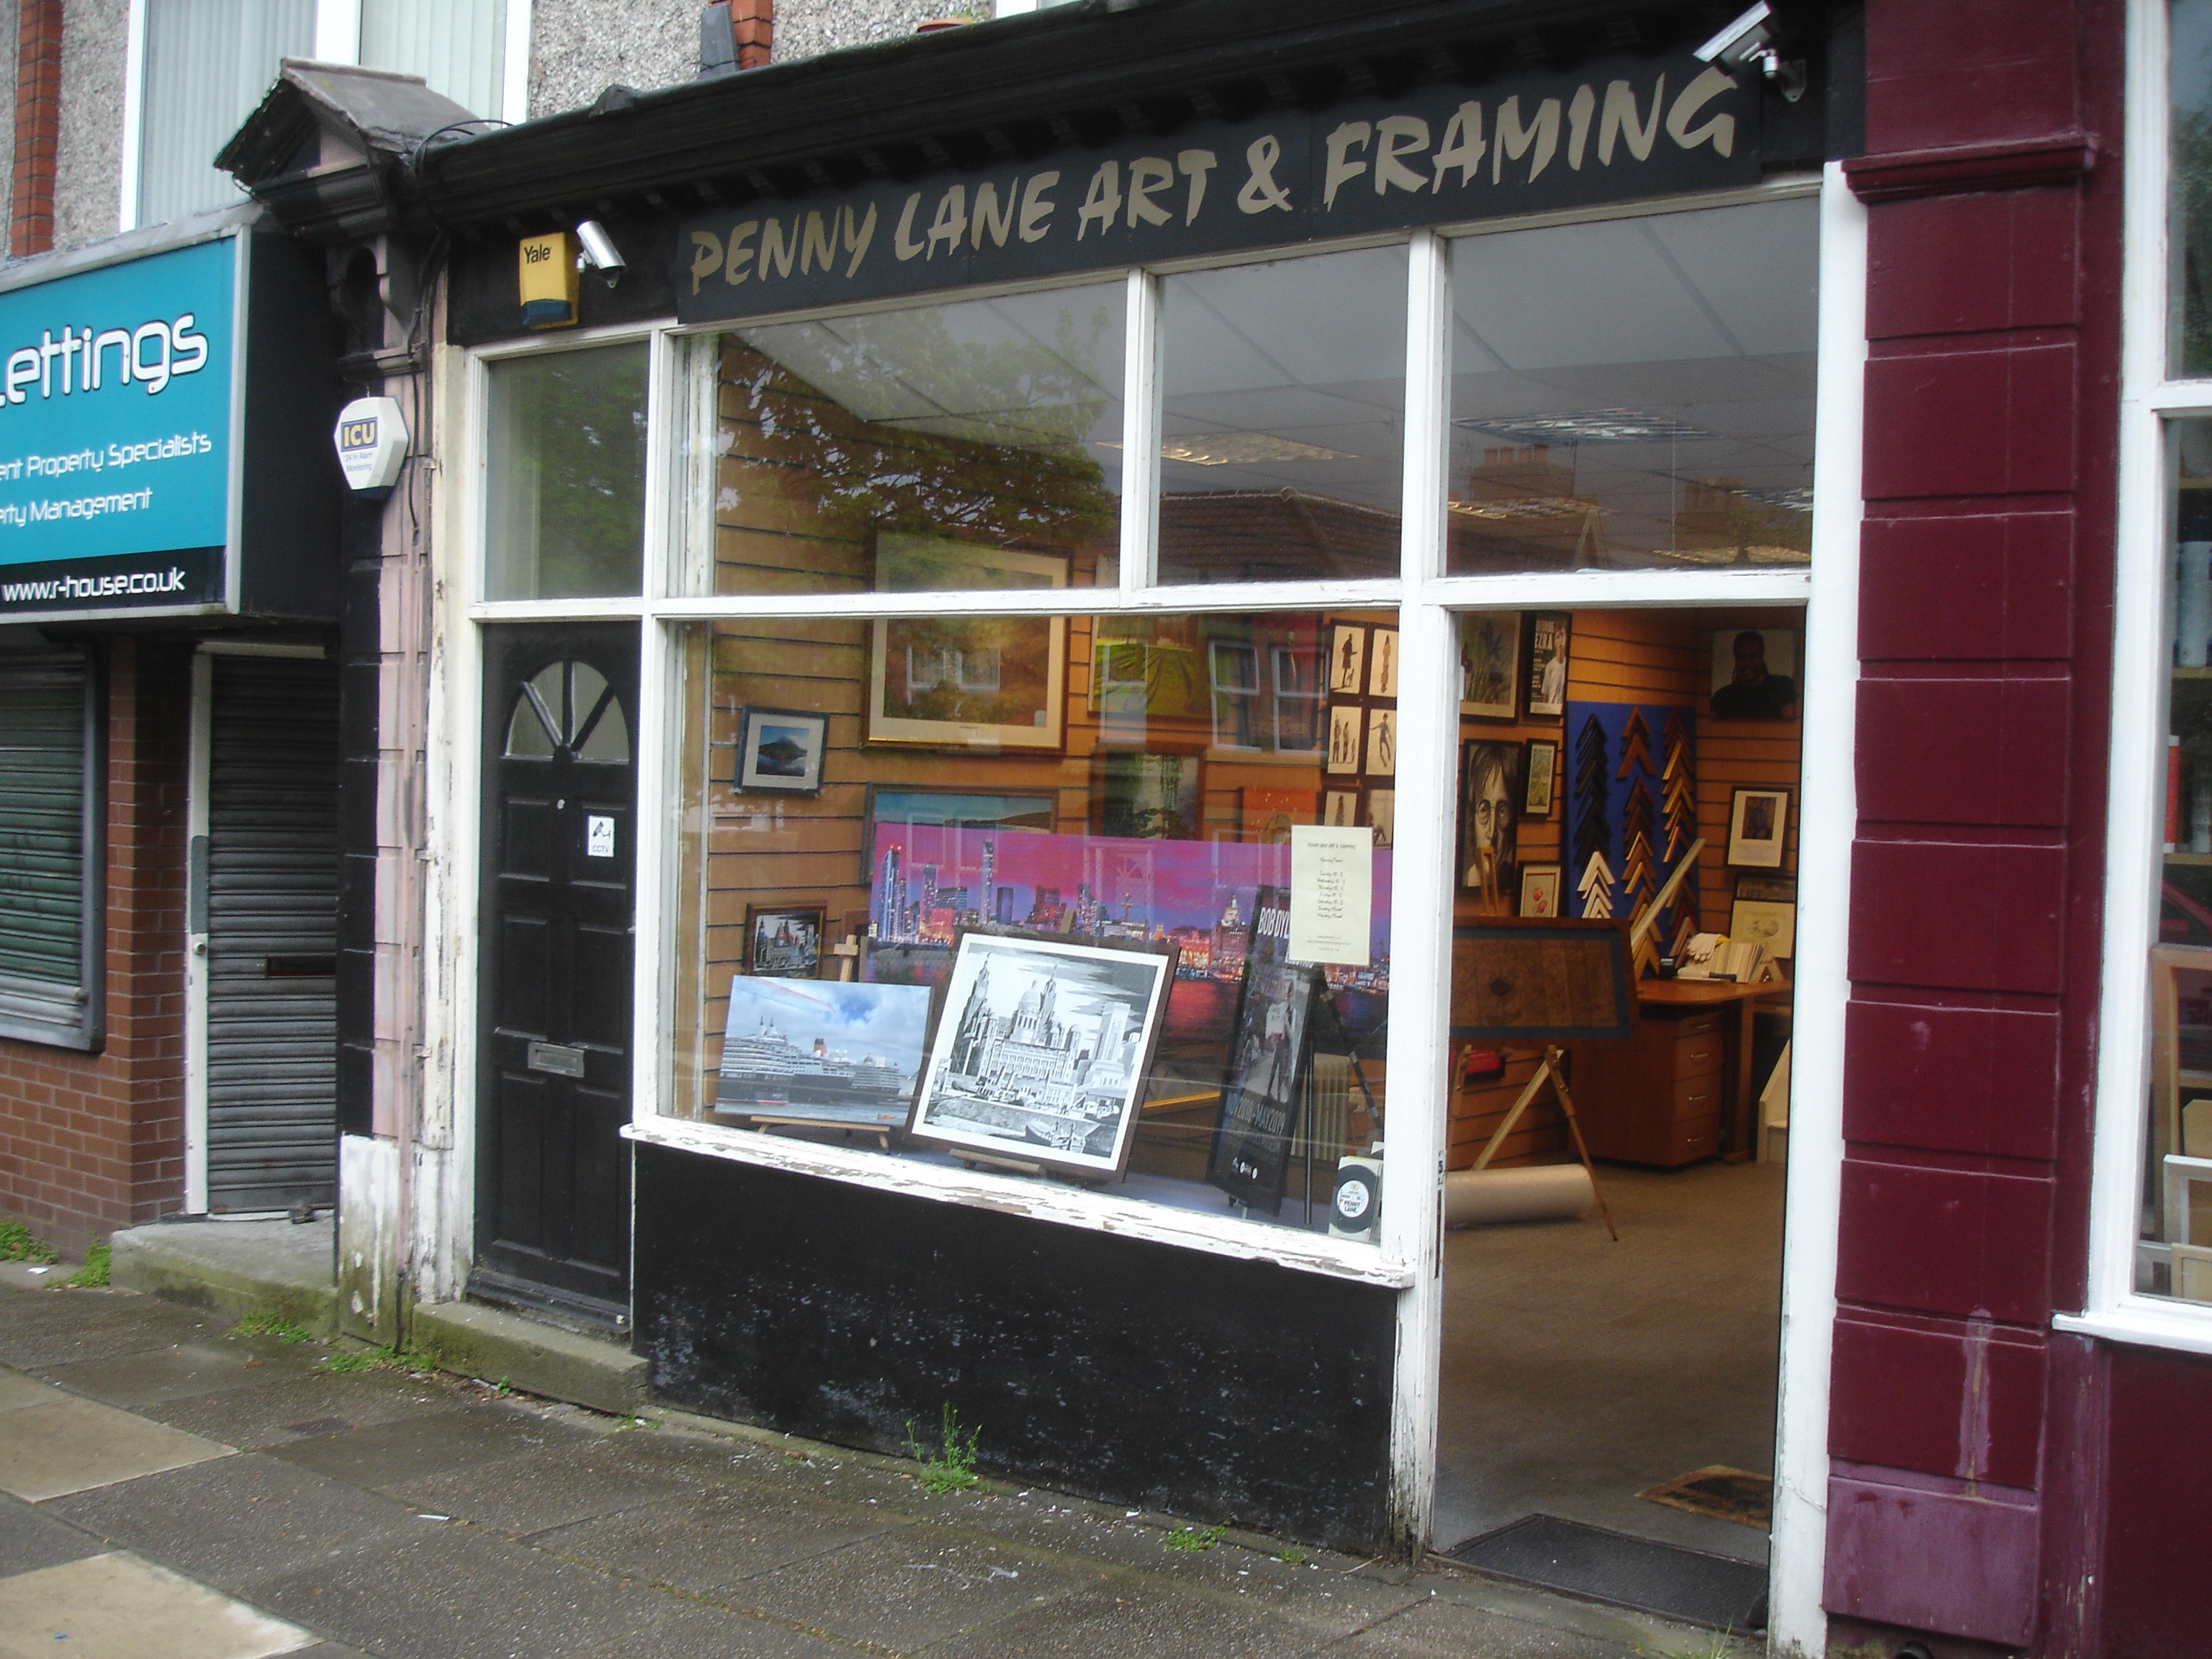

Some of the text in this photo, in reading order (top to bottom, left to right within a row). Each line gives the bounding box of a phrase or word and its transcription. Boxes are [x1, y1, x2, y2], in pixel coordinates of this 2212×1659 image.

[691, 66, 1738, 296] PENNY LANE ART & FRAMING
[524, 243, 550, 264] Yale
[0, 313, 209, 407] ettings
[344, 422, 375, 447] ICU
[26, 448, 104, 479] Property
[108, 431, 212, 469] Specialists
[30, 487, 153, 521] Management
[2, 566, 186, 603] www.r-house.co.uk
[1256, 907, 1290, 940] BOB DYL
